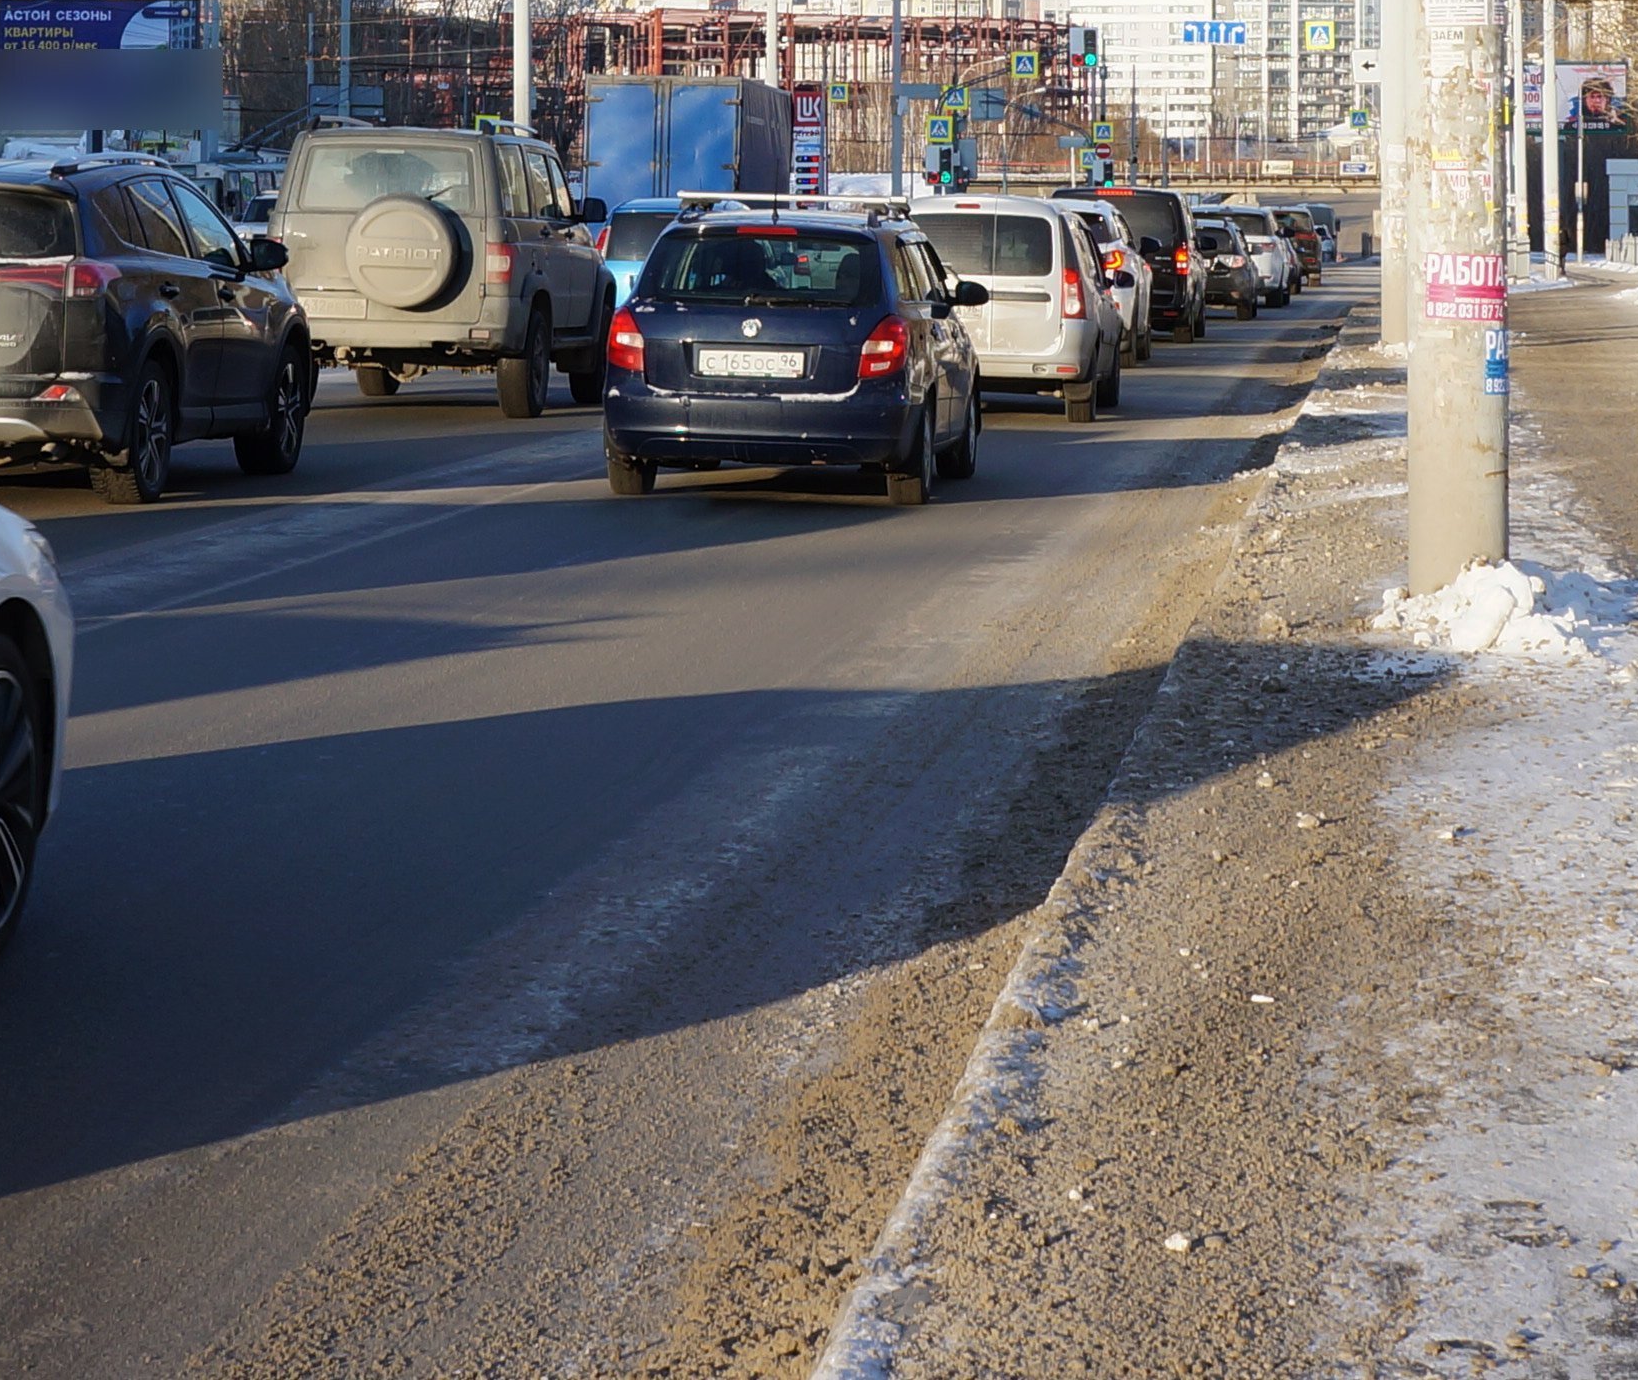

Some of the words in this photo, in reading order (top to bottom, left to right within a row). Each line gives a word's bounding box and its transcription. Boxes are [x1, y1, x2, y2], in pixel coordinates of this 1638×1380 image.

[4, 10, 50, 21] АСТОН
[56, 10, 112, 21] СЕЗОНЫ
[4, 27, 73, 38] КВАРТИРЫ
[4, 41, 17, 50] от
[38, 40, 60, 50] 400
[356, 246, 442, 260] PATRIOT
[1426, 254, 1505, 286] РАБОТА
[1426, 301, 1435, 317] 8
[1435, 302, 1457, 318] 922
[1458, 304, 1480, 319] 031
[780, 353, 797, 368] 96
